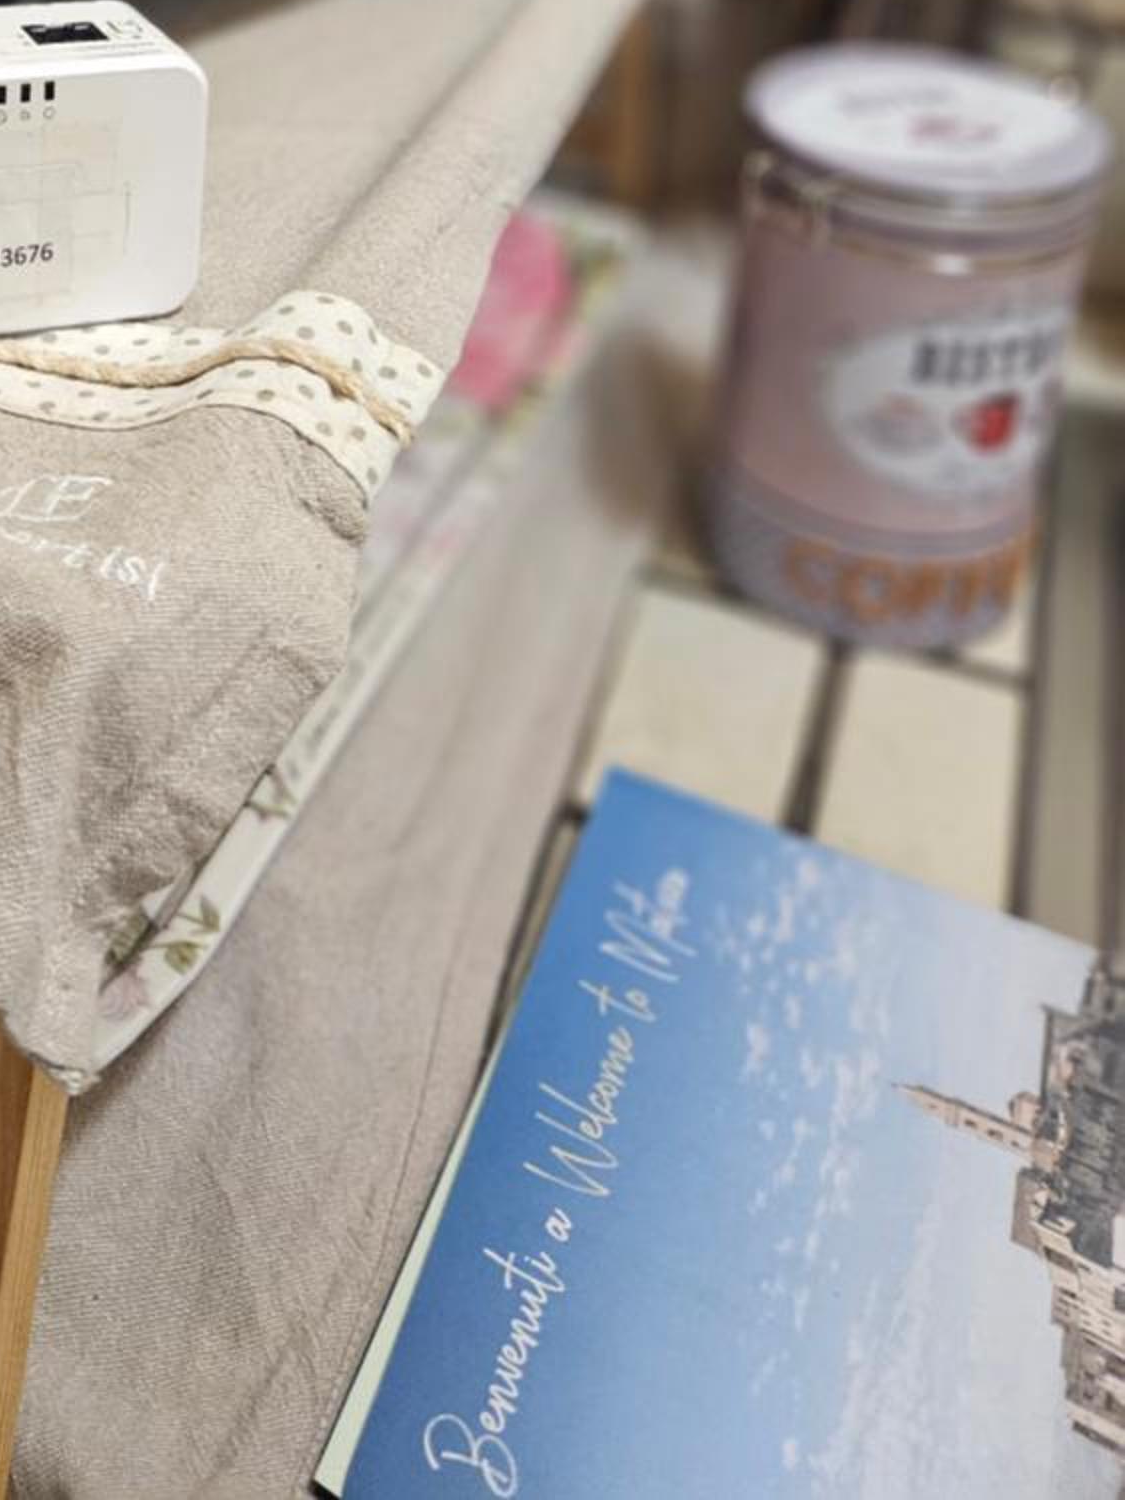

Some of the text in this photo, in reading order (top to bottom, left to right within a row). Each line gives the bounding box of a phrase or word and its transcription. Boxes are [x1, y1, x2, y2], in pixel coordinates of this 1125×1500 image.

[578, 979, 656, 1023] to
[524, 1026, 634, 1197] Welcome
[547, 1208, 573, 1241] a
[423, 1247, 566, 1498] Benvenuti
